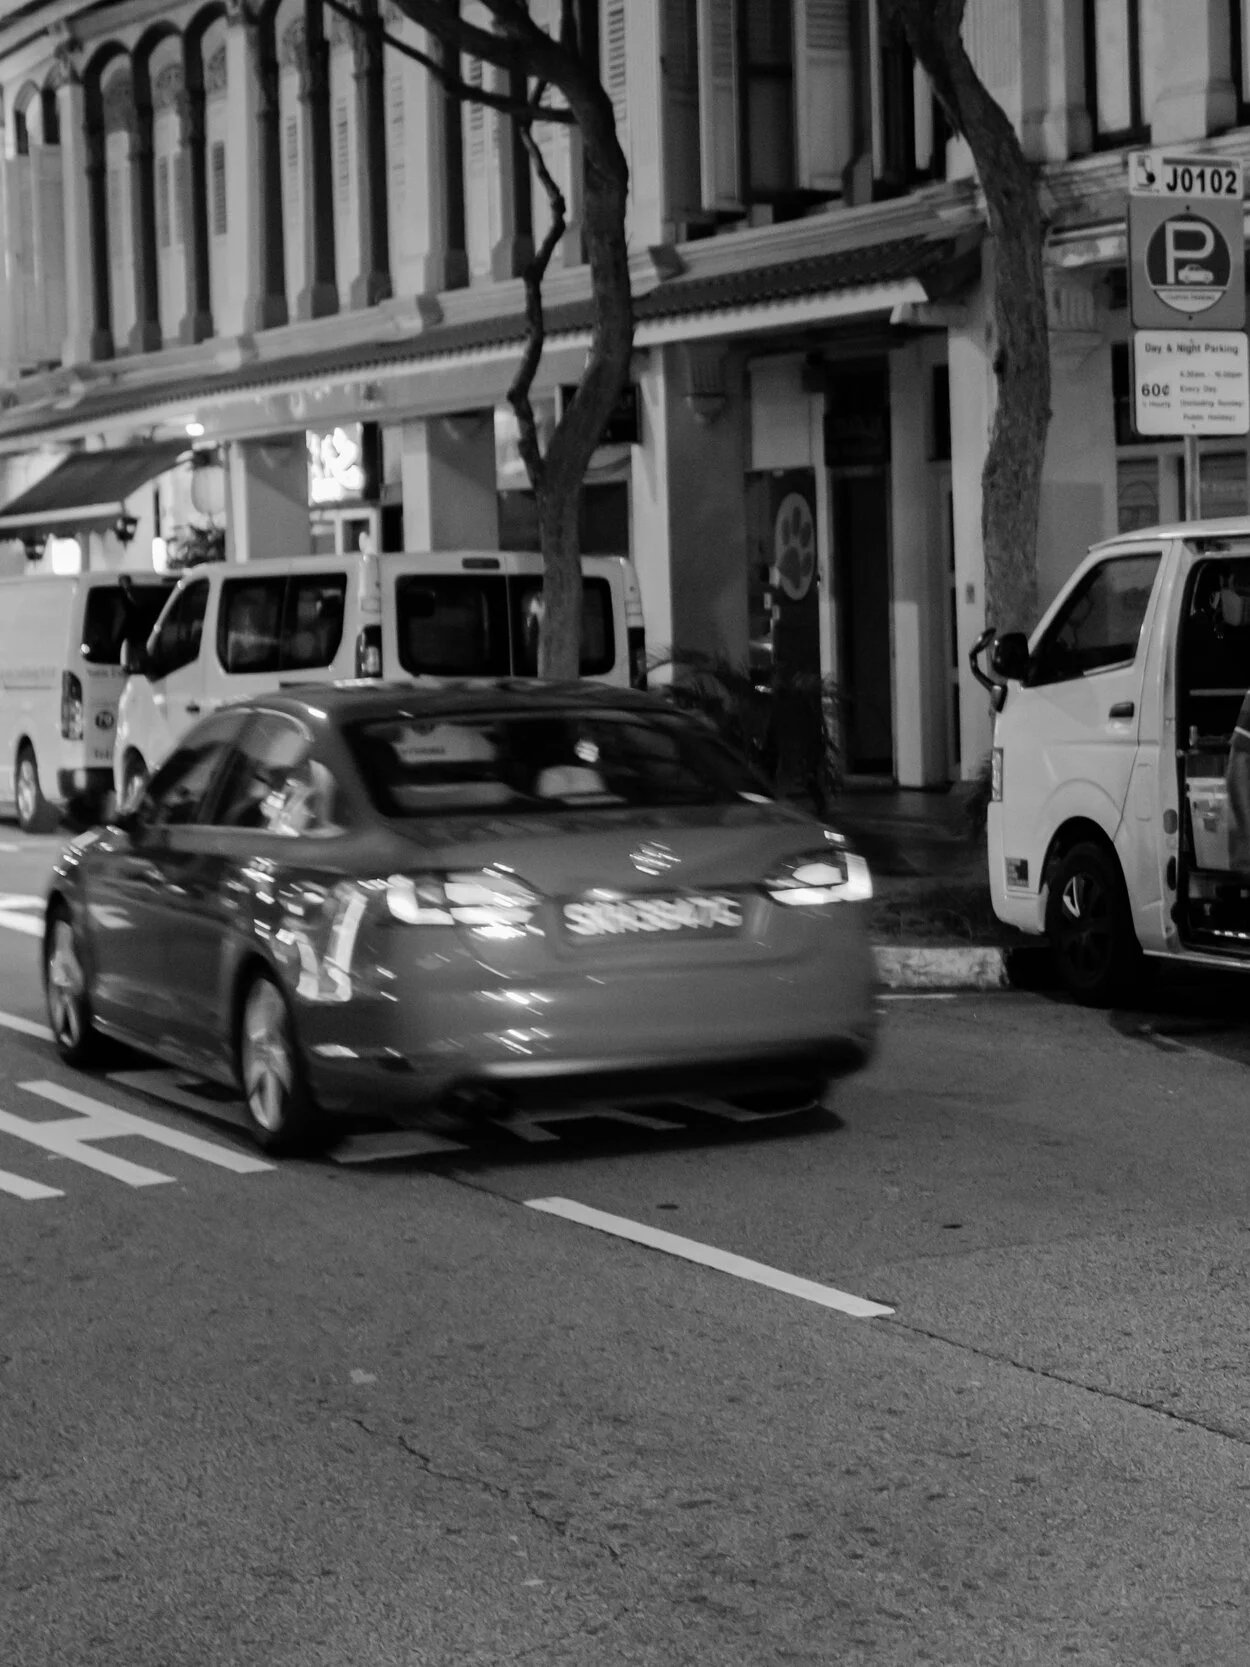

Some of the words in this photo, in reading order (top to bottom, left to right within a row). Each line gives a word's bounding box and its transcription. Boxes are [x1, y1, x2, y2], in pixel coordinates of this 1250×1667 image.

[1166, 166, 1237, 194] J0102
[1165, 221, 1215, 284] P
[1144, 343, 1162, 355] Day
[1166, 344, 1173, 353] &
[1176, 344, 1201, 356] Night
[1204, 344, 1239, 356] Parking
[1141, 383, 1170, 397] 60¢
[1203, 385, 1217, 394] Day
